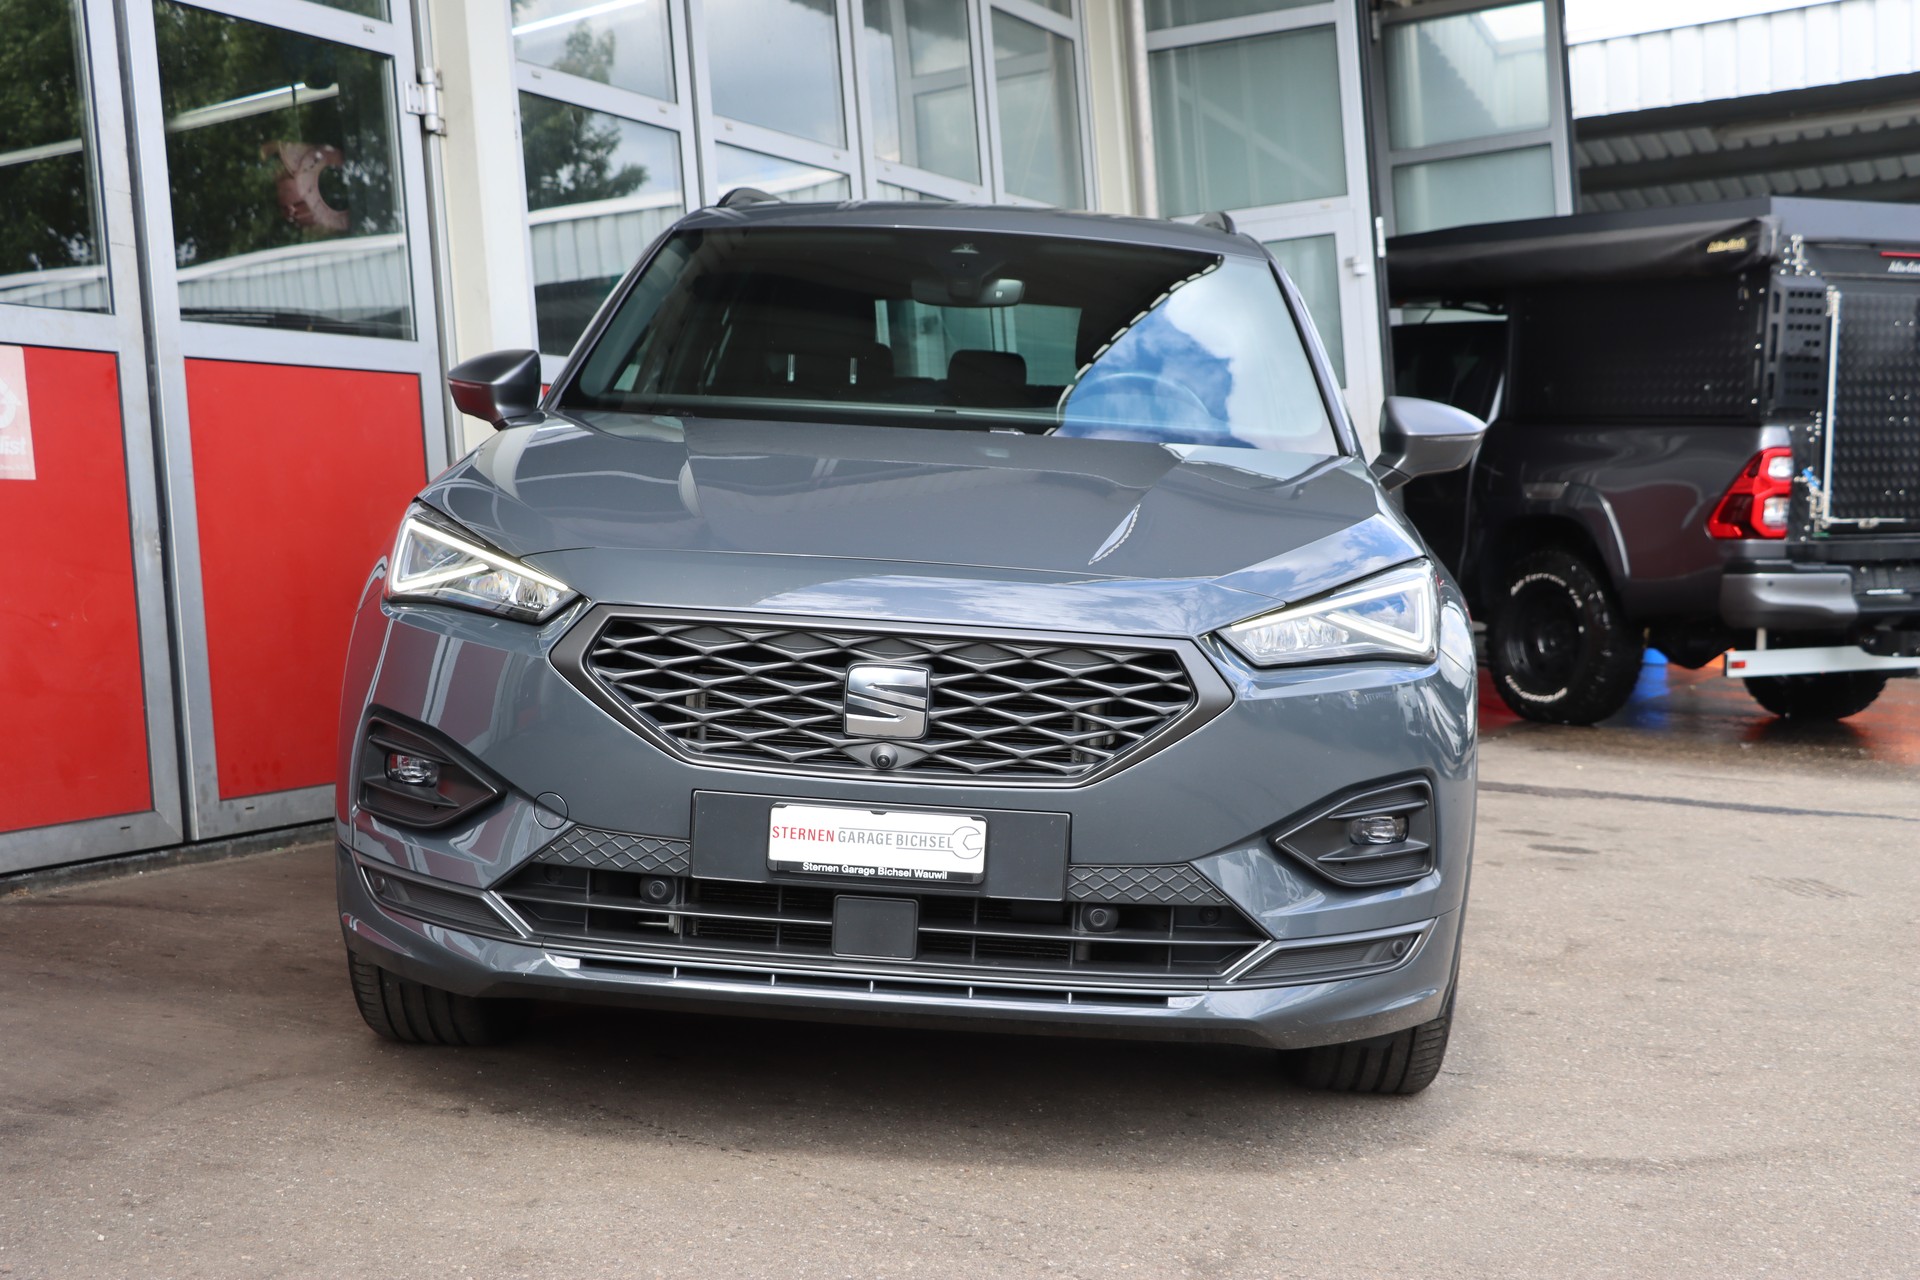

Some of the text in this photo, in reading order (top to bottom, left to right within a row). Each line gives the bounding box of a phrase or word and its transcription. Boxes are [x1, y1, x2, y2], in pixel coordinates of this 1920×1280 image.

[772, 826, 954, 849] STERNEN GARAGE BICHSEL
[802, 862, 948, 880] Sternen Garage Bichsel Wauwil
